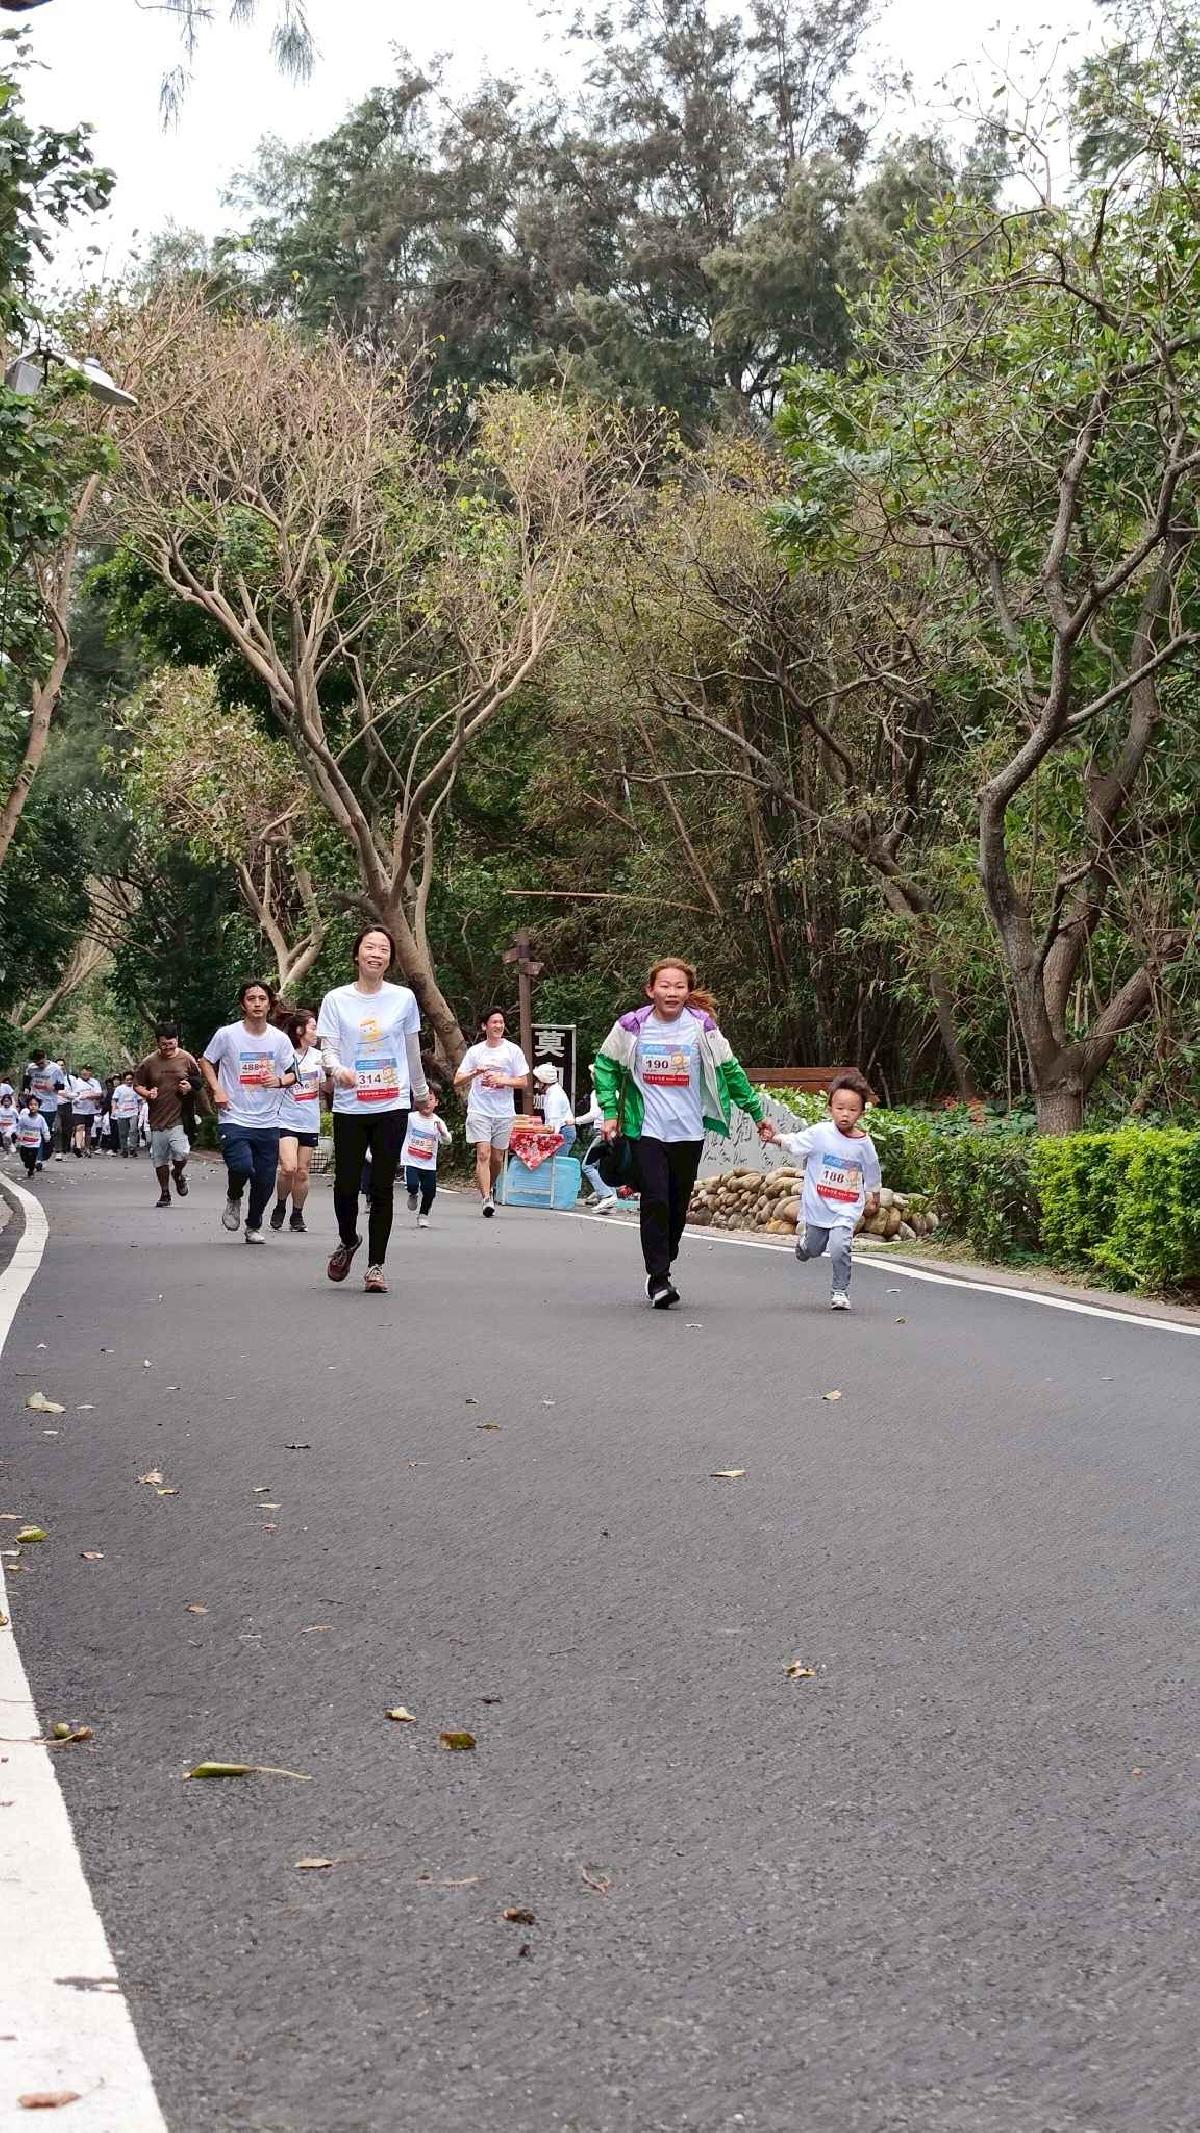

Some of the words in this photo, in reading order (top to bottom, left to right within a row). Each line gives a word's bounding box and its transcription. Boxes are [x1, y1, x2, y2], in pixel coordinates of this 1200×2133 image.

[645, 1060, 669, 1069] 190
[358, 1074, 381, 1084] 314
[824, 1170, 845, 1183] 188
